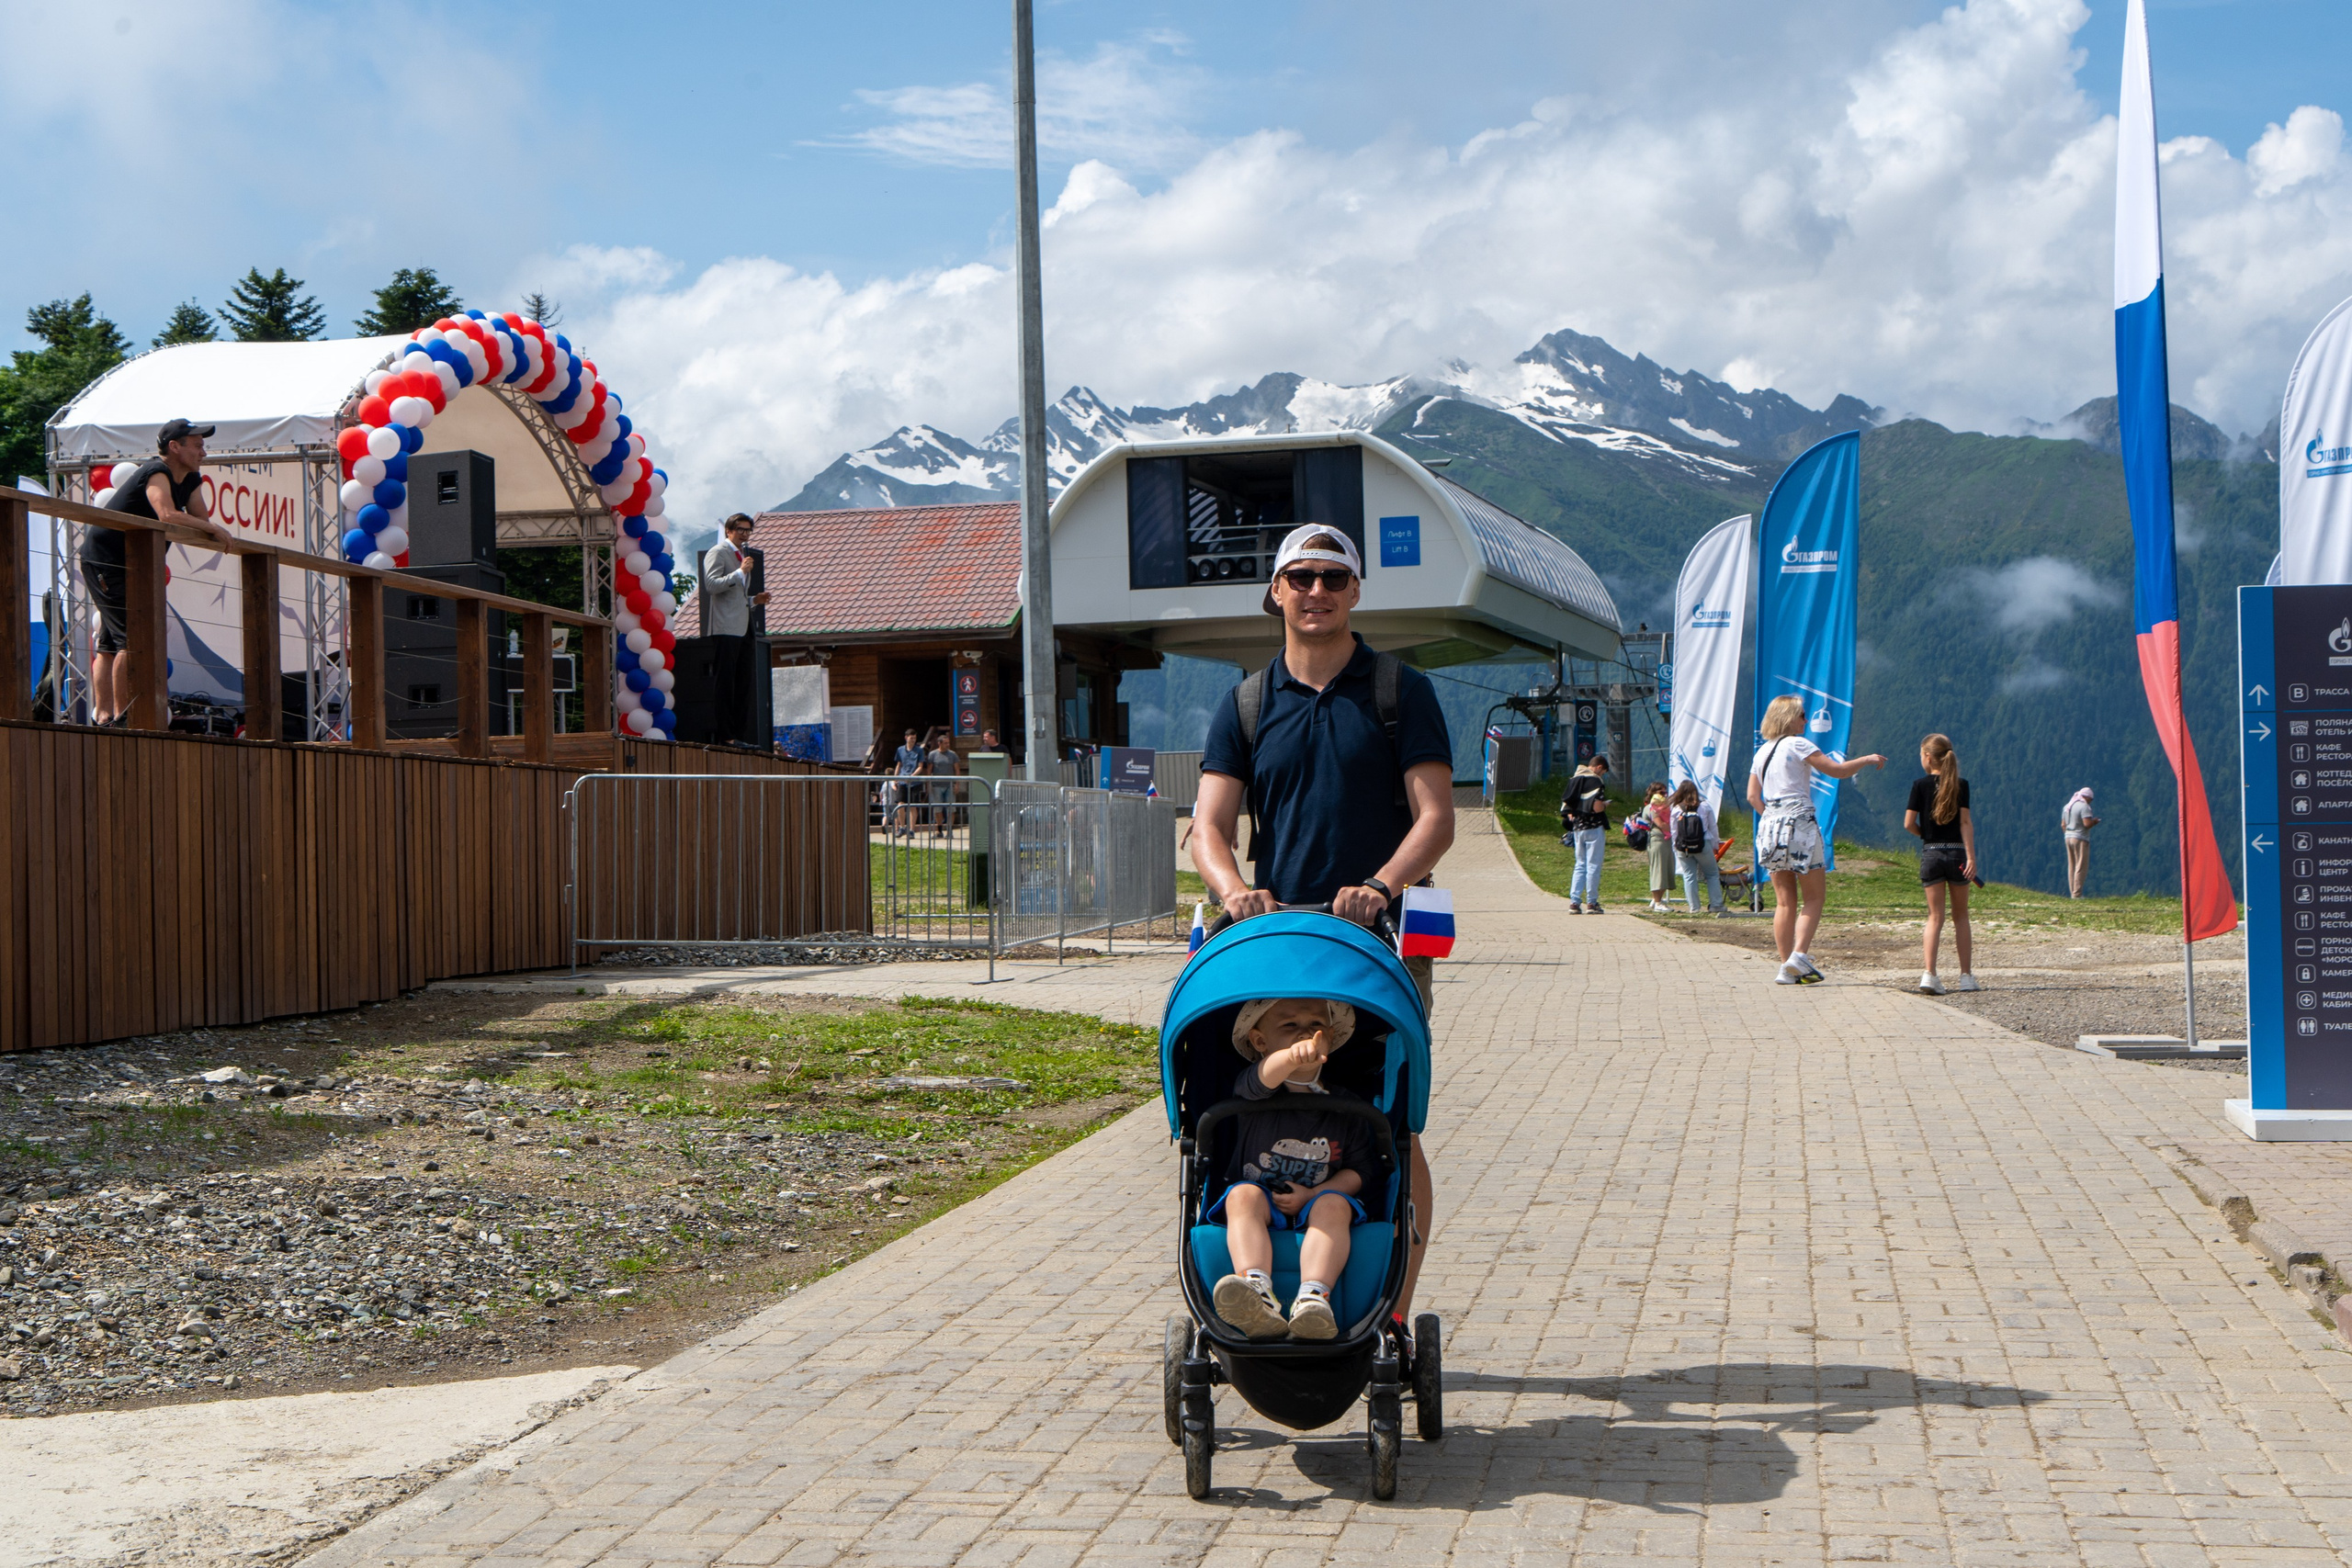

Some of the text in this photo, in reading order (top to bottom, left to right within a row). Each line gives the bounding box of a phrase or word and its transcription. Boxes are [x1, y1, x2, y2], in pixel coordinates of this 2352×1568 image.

[201, 475, 295, 538] ОССИИ!
[2316, 752, 2352, 761] РЕСТОР
[2319, 868, 2348, 876] ЦЕНТР
[2321, 946, 2352, 954] ДЕТСК
